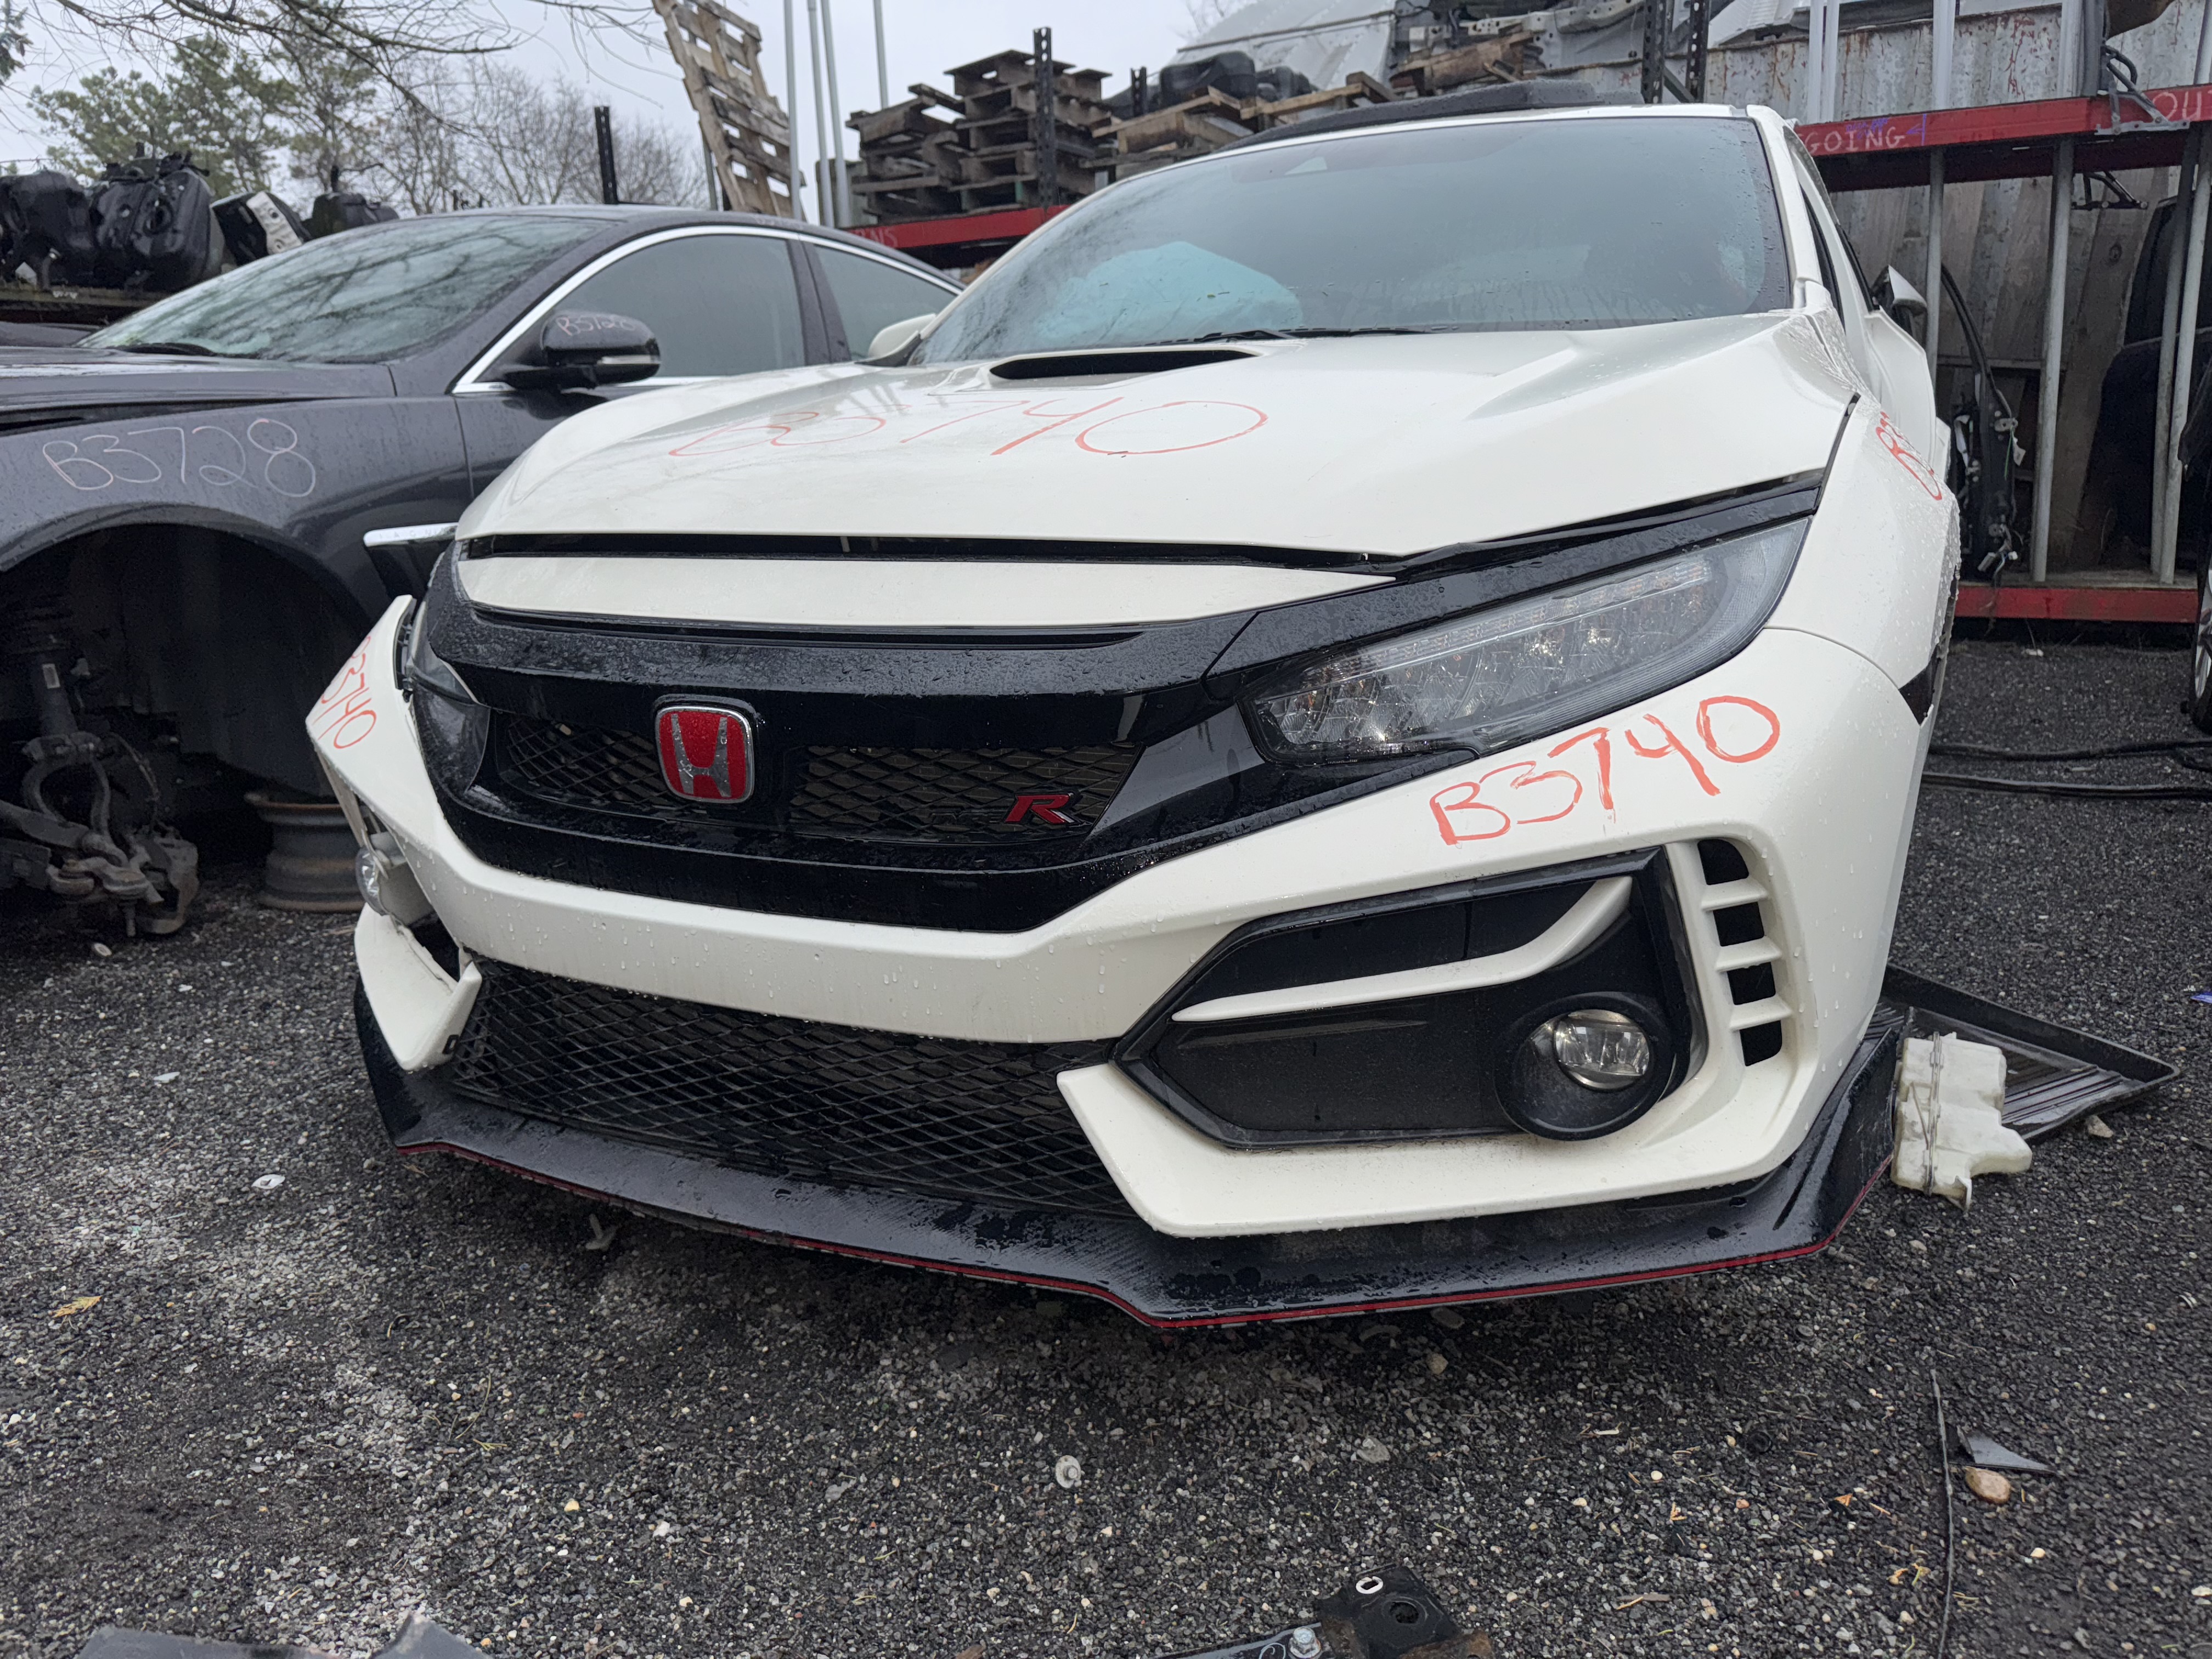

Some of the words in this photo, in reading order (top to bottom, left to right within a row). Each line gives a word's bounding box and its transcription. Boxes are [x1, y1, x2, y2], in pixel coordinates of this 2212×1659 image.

[2152, 90, 2212, 120] OU
[1798, 126, 1906, 154] GOING
[42, 419, 316, 498] B3728
[1430, 696, 1780, 845] B3740
[1005, 793, 1076, 824] R
